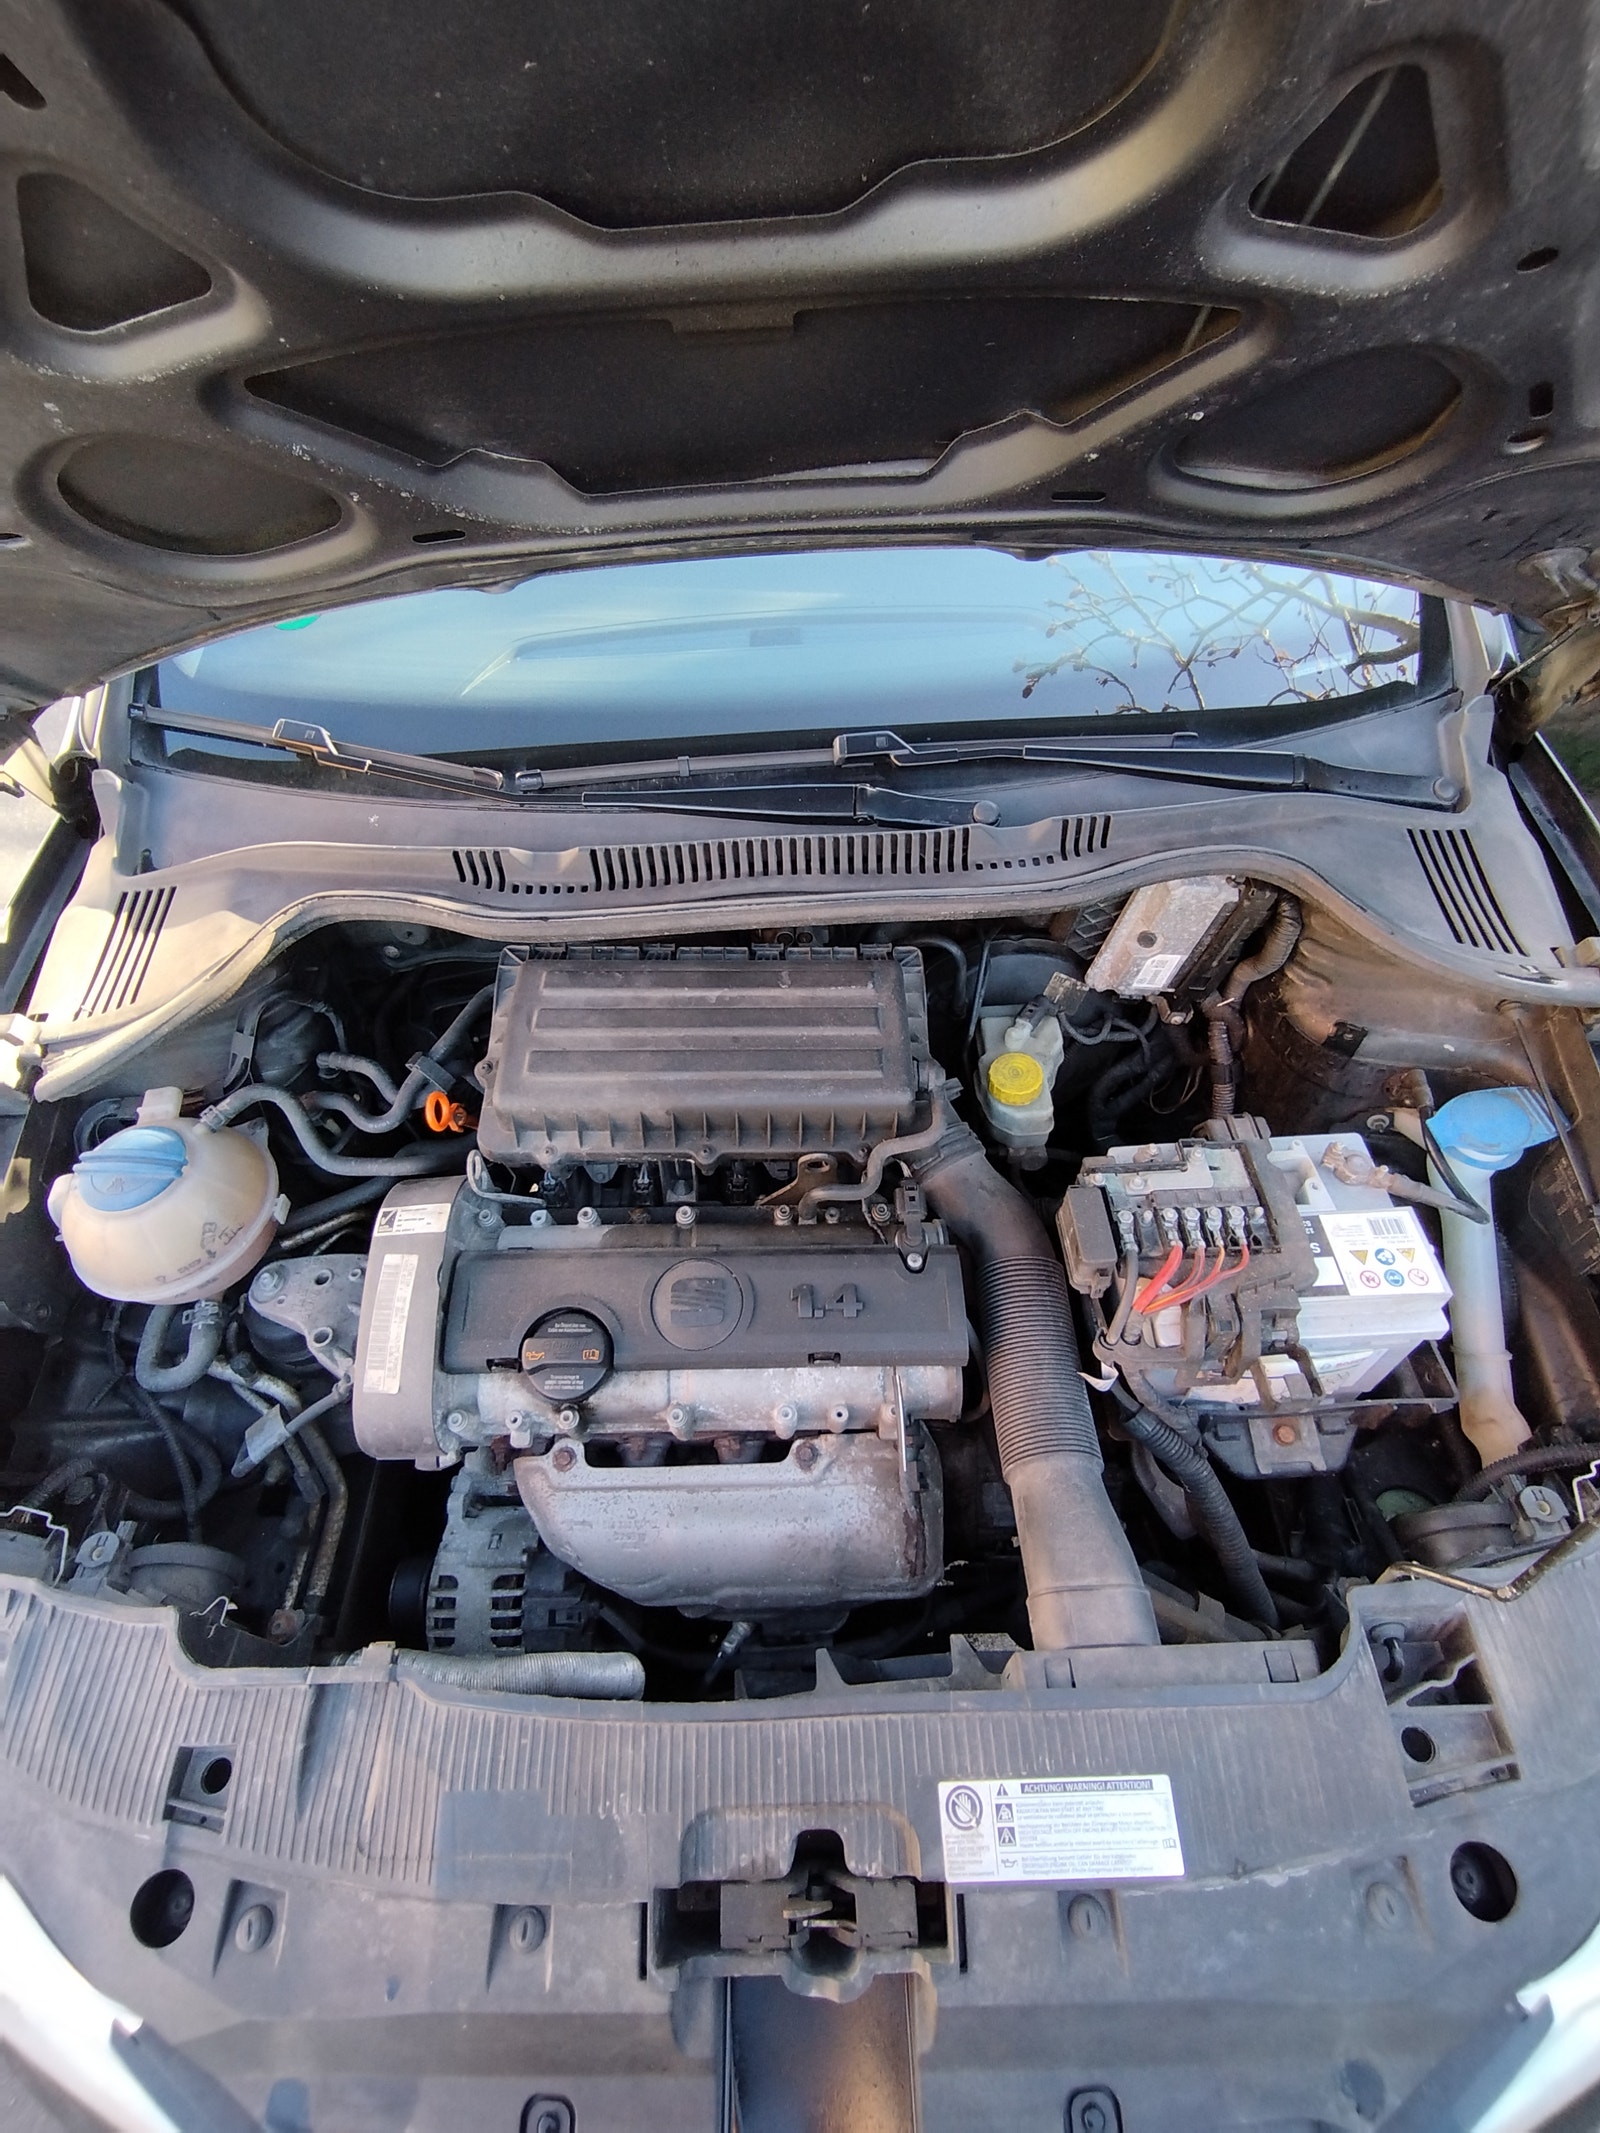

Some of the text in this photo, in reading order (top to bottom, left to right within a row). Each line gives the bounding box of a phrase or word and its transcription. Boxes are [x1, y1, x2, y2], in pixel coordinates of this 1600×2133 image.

[789, 1282, 865, 1319] 1.4
[1023, 1780, 1151, 1793] ACHTUNG! WARNING! ATTENTION!
